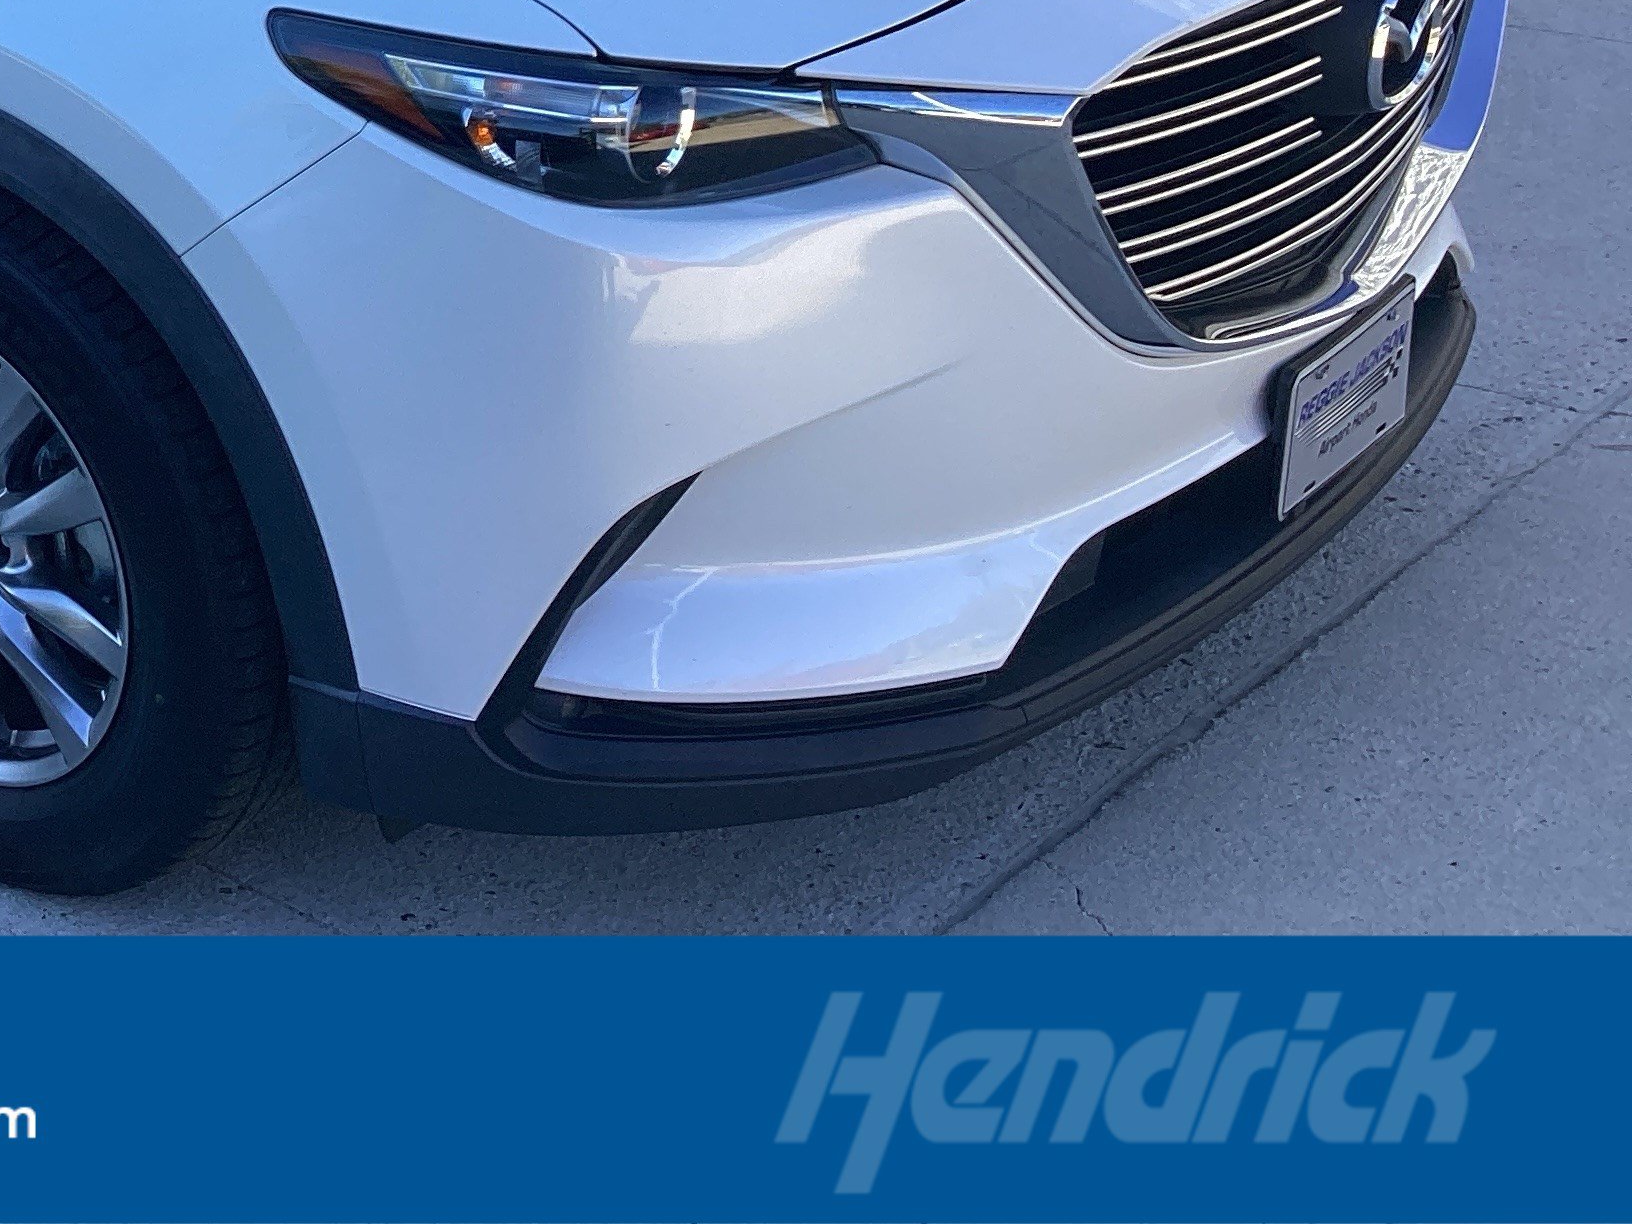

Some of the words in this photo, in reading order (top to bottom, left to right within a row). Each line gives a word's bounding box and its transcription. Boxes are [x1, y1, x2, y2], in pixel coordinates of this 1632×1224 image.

[1300, 371, 1349, 424] REGGIE
[1351, 323, 1408, 384] JACKSON
[1319, 426, 1351, 457] Airport
[1353, 401, 1378, 427] Honda
